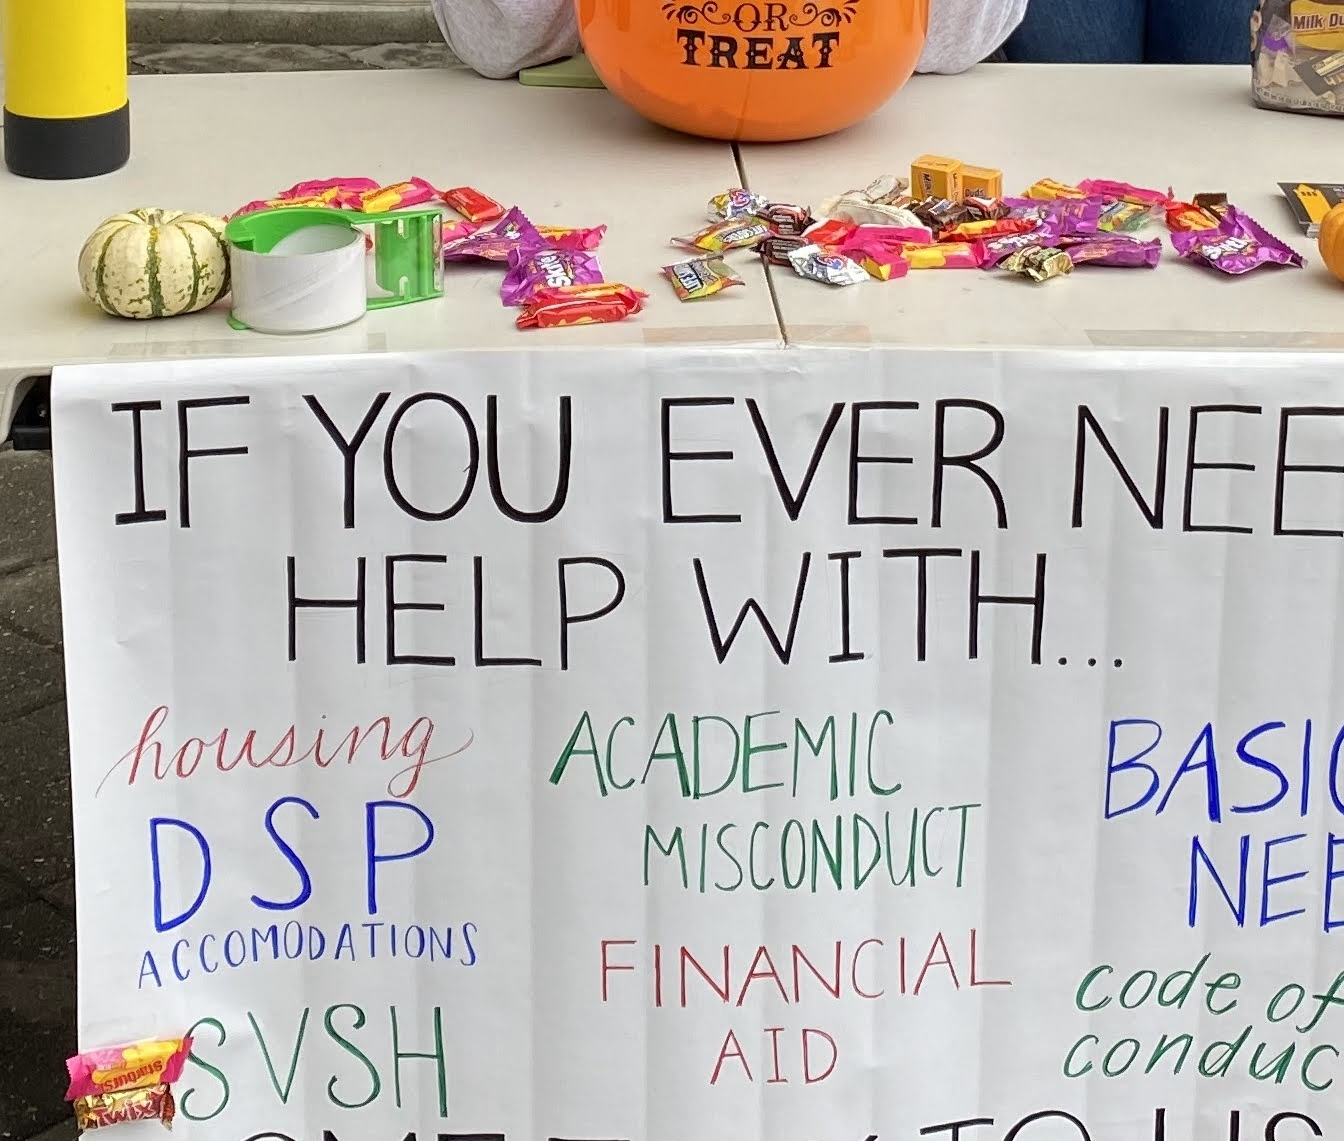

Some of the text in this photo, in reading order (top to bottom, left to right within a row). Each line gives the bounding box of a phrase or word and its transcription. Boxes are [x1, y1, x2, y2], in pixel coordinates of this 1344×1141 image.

[677, 28, 841, 71] TREAT
[733, 3, 790, 32] OR
[1292, 14, 1324, 30] Milk
[111, 395, 250, 529] IF
[301, 391, 572, 530] YOU
[660, 396, 1008, 529] EVER
[287, 554, 626, 670] HELP
[95, 705, 475, 798] housing
[548, 709, 902, 801] ACADEMIC
[643, 803, 982, 894] MISCONDUCT
[137, 919, 478, 990] ACCOMODATIONS
[600, 927, 1013, 1008] FINANCIAL
[1075, 951, 1242, 1015] code
[179, 1003, 449, 1121] SVSH
[709, 1026, 838, 1085] AID
